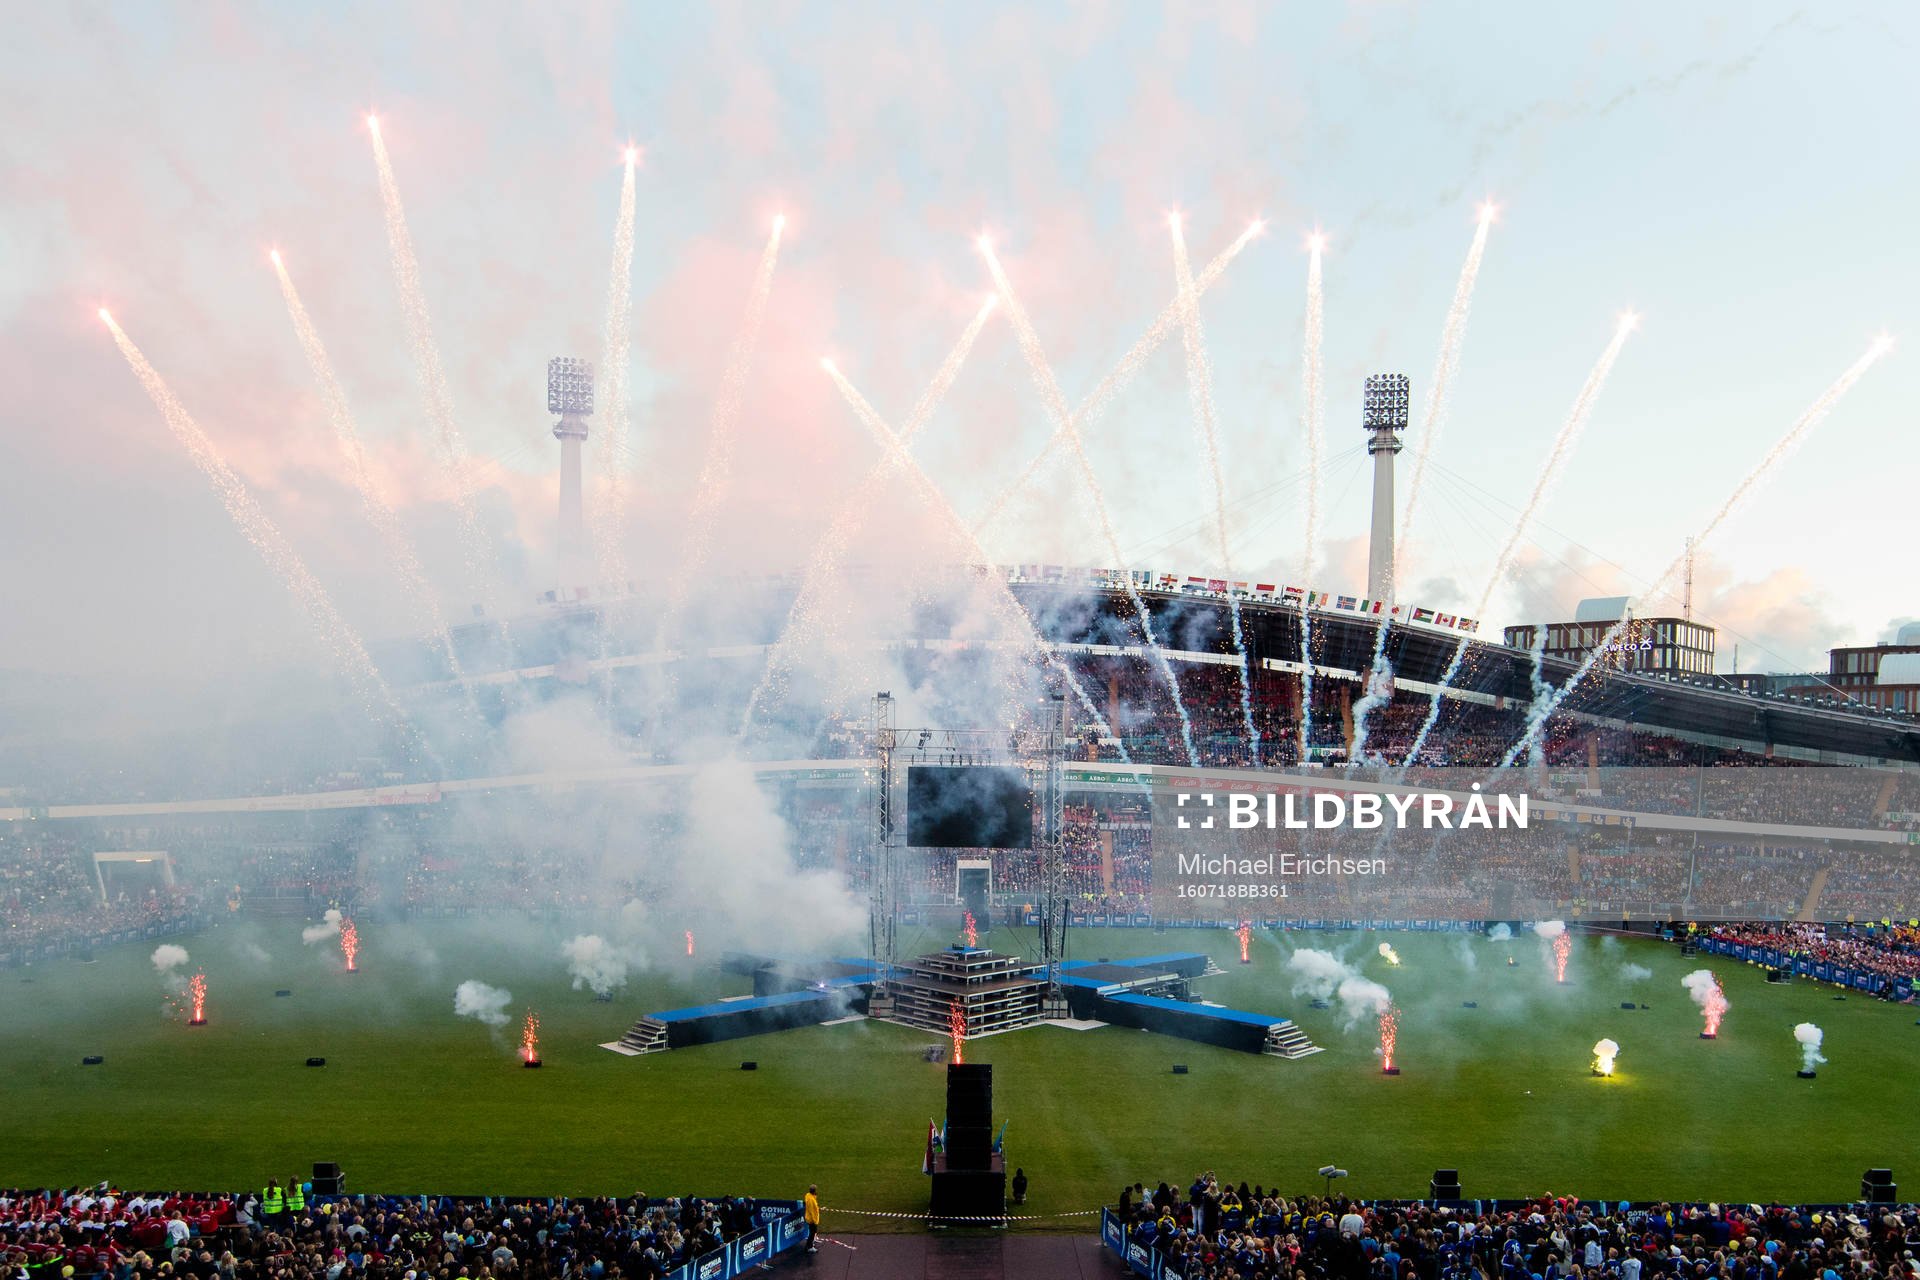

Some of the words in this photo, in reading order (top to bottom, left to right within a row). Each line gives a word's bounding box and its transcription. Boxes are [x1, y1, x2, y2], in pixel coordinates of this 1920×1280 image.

[761, 1206, 791, 1214] GOTHIA
[743, 1236, 765, 1250] GOTHIA
[743, 1247, 755, 1257] CUP
